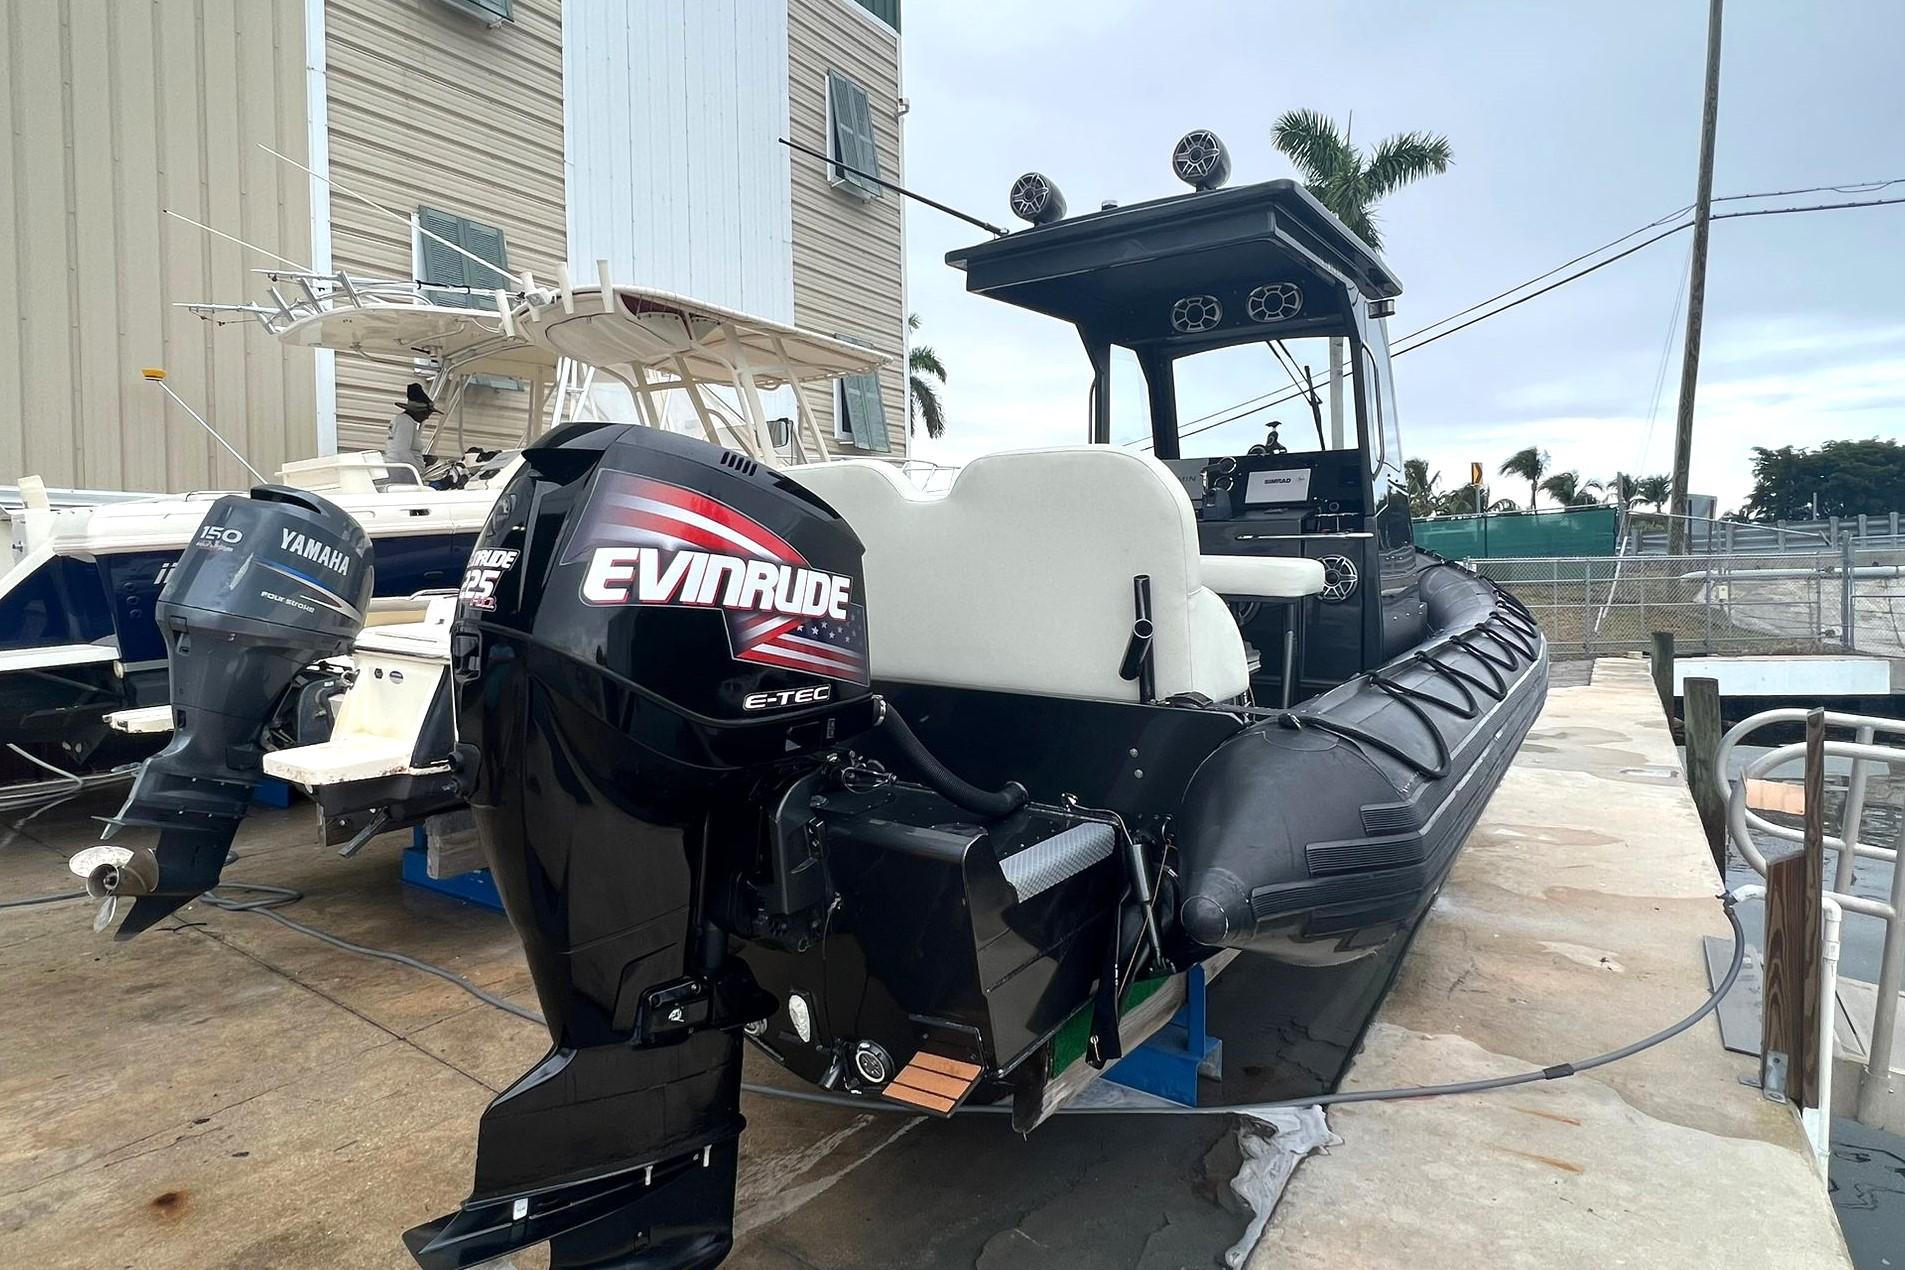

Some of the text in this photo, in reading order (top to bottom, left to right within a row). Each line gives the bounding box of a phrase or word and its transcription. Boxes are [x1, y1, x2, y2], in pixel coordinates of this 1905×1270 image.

[200, 525, 243, 543] 150
[280, 527, 350, 576] YAMAHA
[582, 547, 851, 622] EVINRUDE
[745, 686, 829, 709] E-TEC
